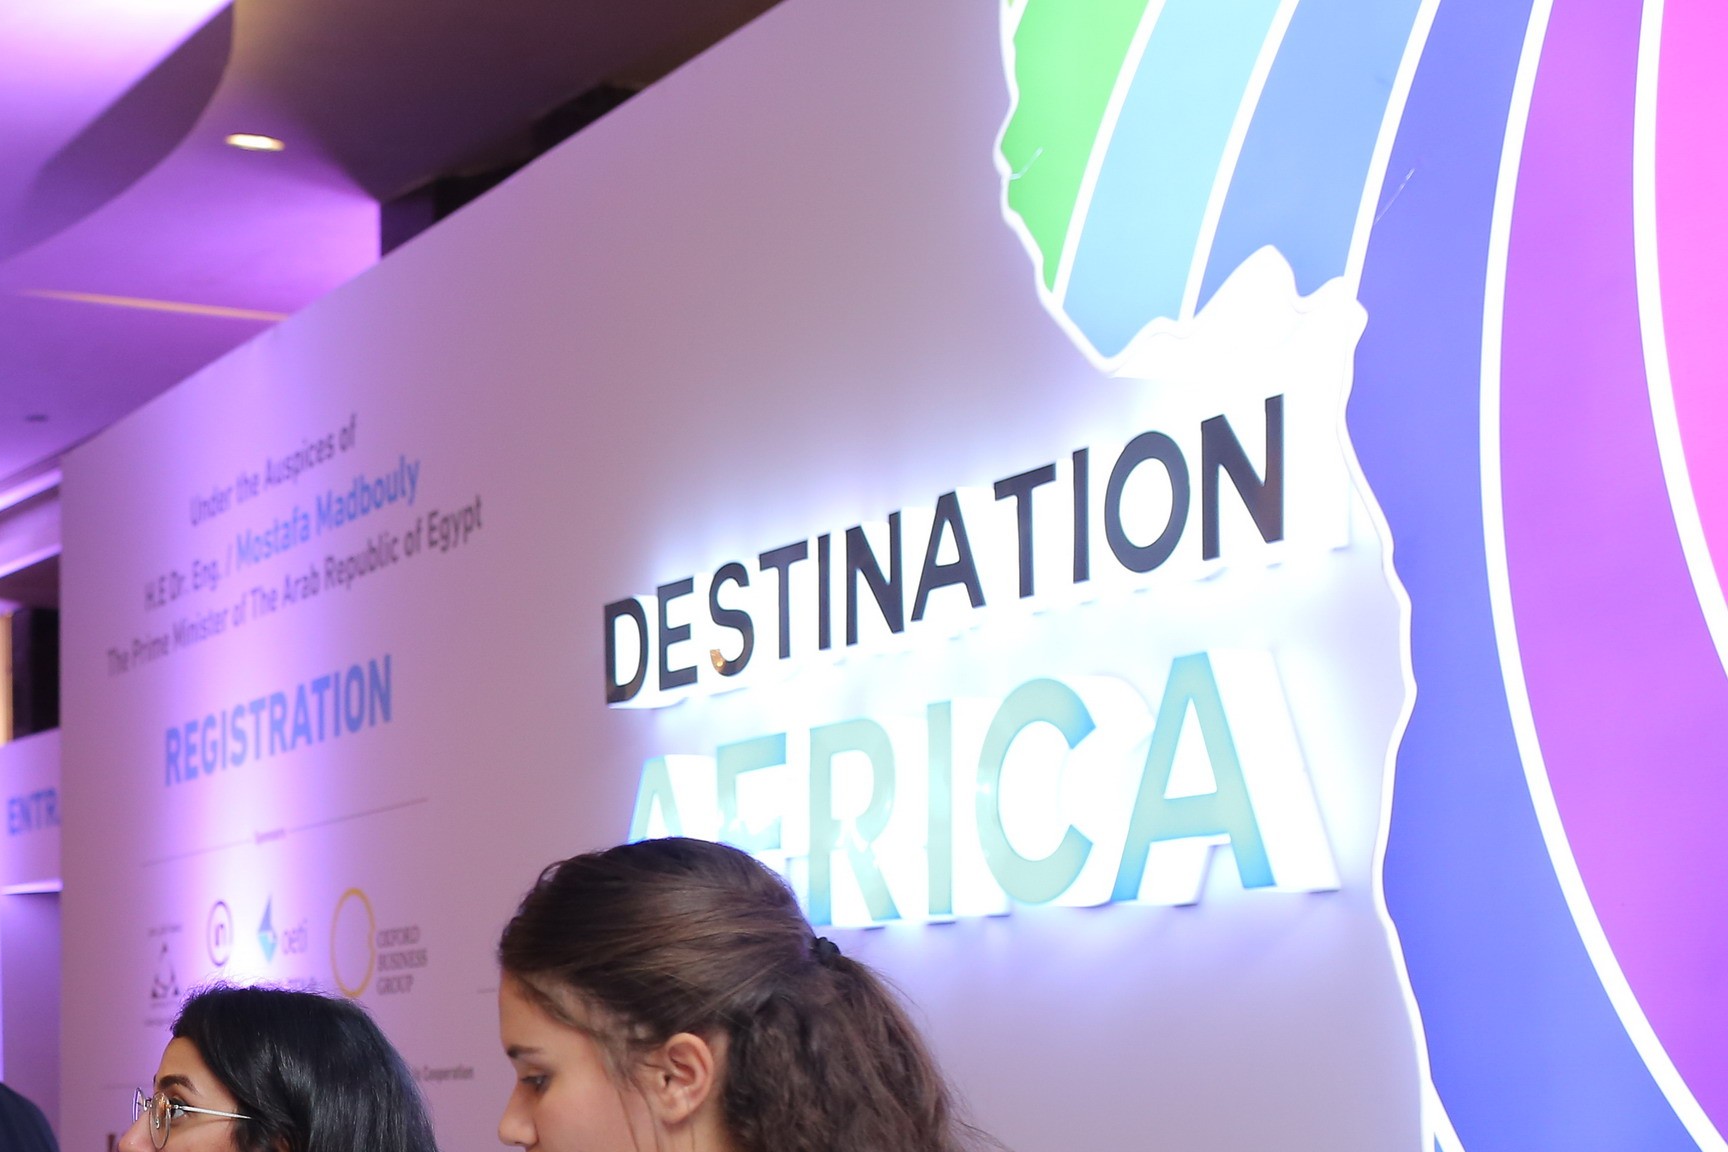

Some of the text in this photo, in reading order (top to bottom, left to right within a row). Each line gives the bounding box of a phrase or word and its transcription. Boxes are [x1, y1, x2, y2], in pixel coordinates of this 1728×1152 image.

[190, 413, 358, 526] Under the Auspices of
[235, 509, 311, 571] Mostafa
[314, 455, 422, 535] Madbouly
[107, 495, 483, 677] The Prime Minister of The Arab Republic of Egypt
[603, 392, 1285, 706] DESTINATION
[164, 653, 393, 787] REGISTRATION
[376, 924, 421, 948] OXFORD
[376, 974, 414, 996] GROUP
[377, 948, 428, 973] BUSINESS
